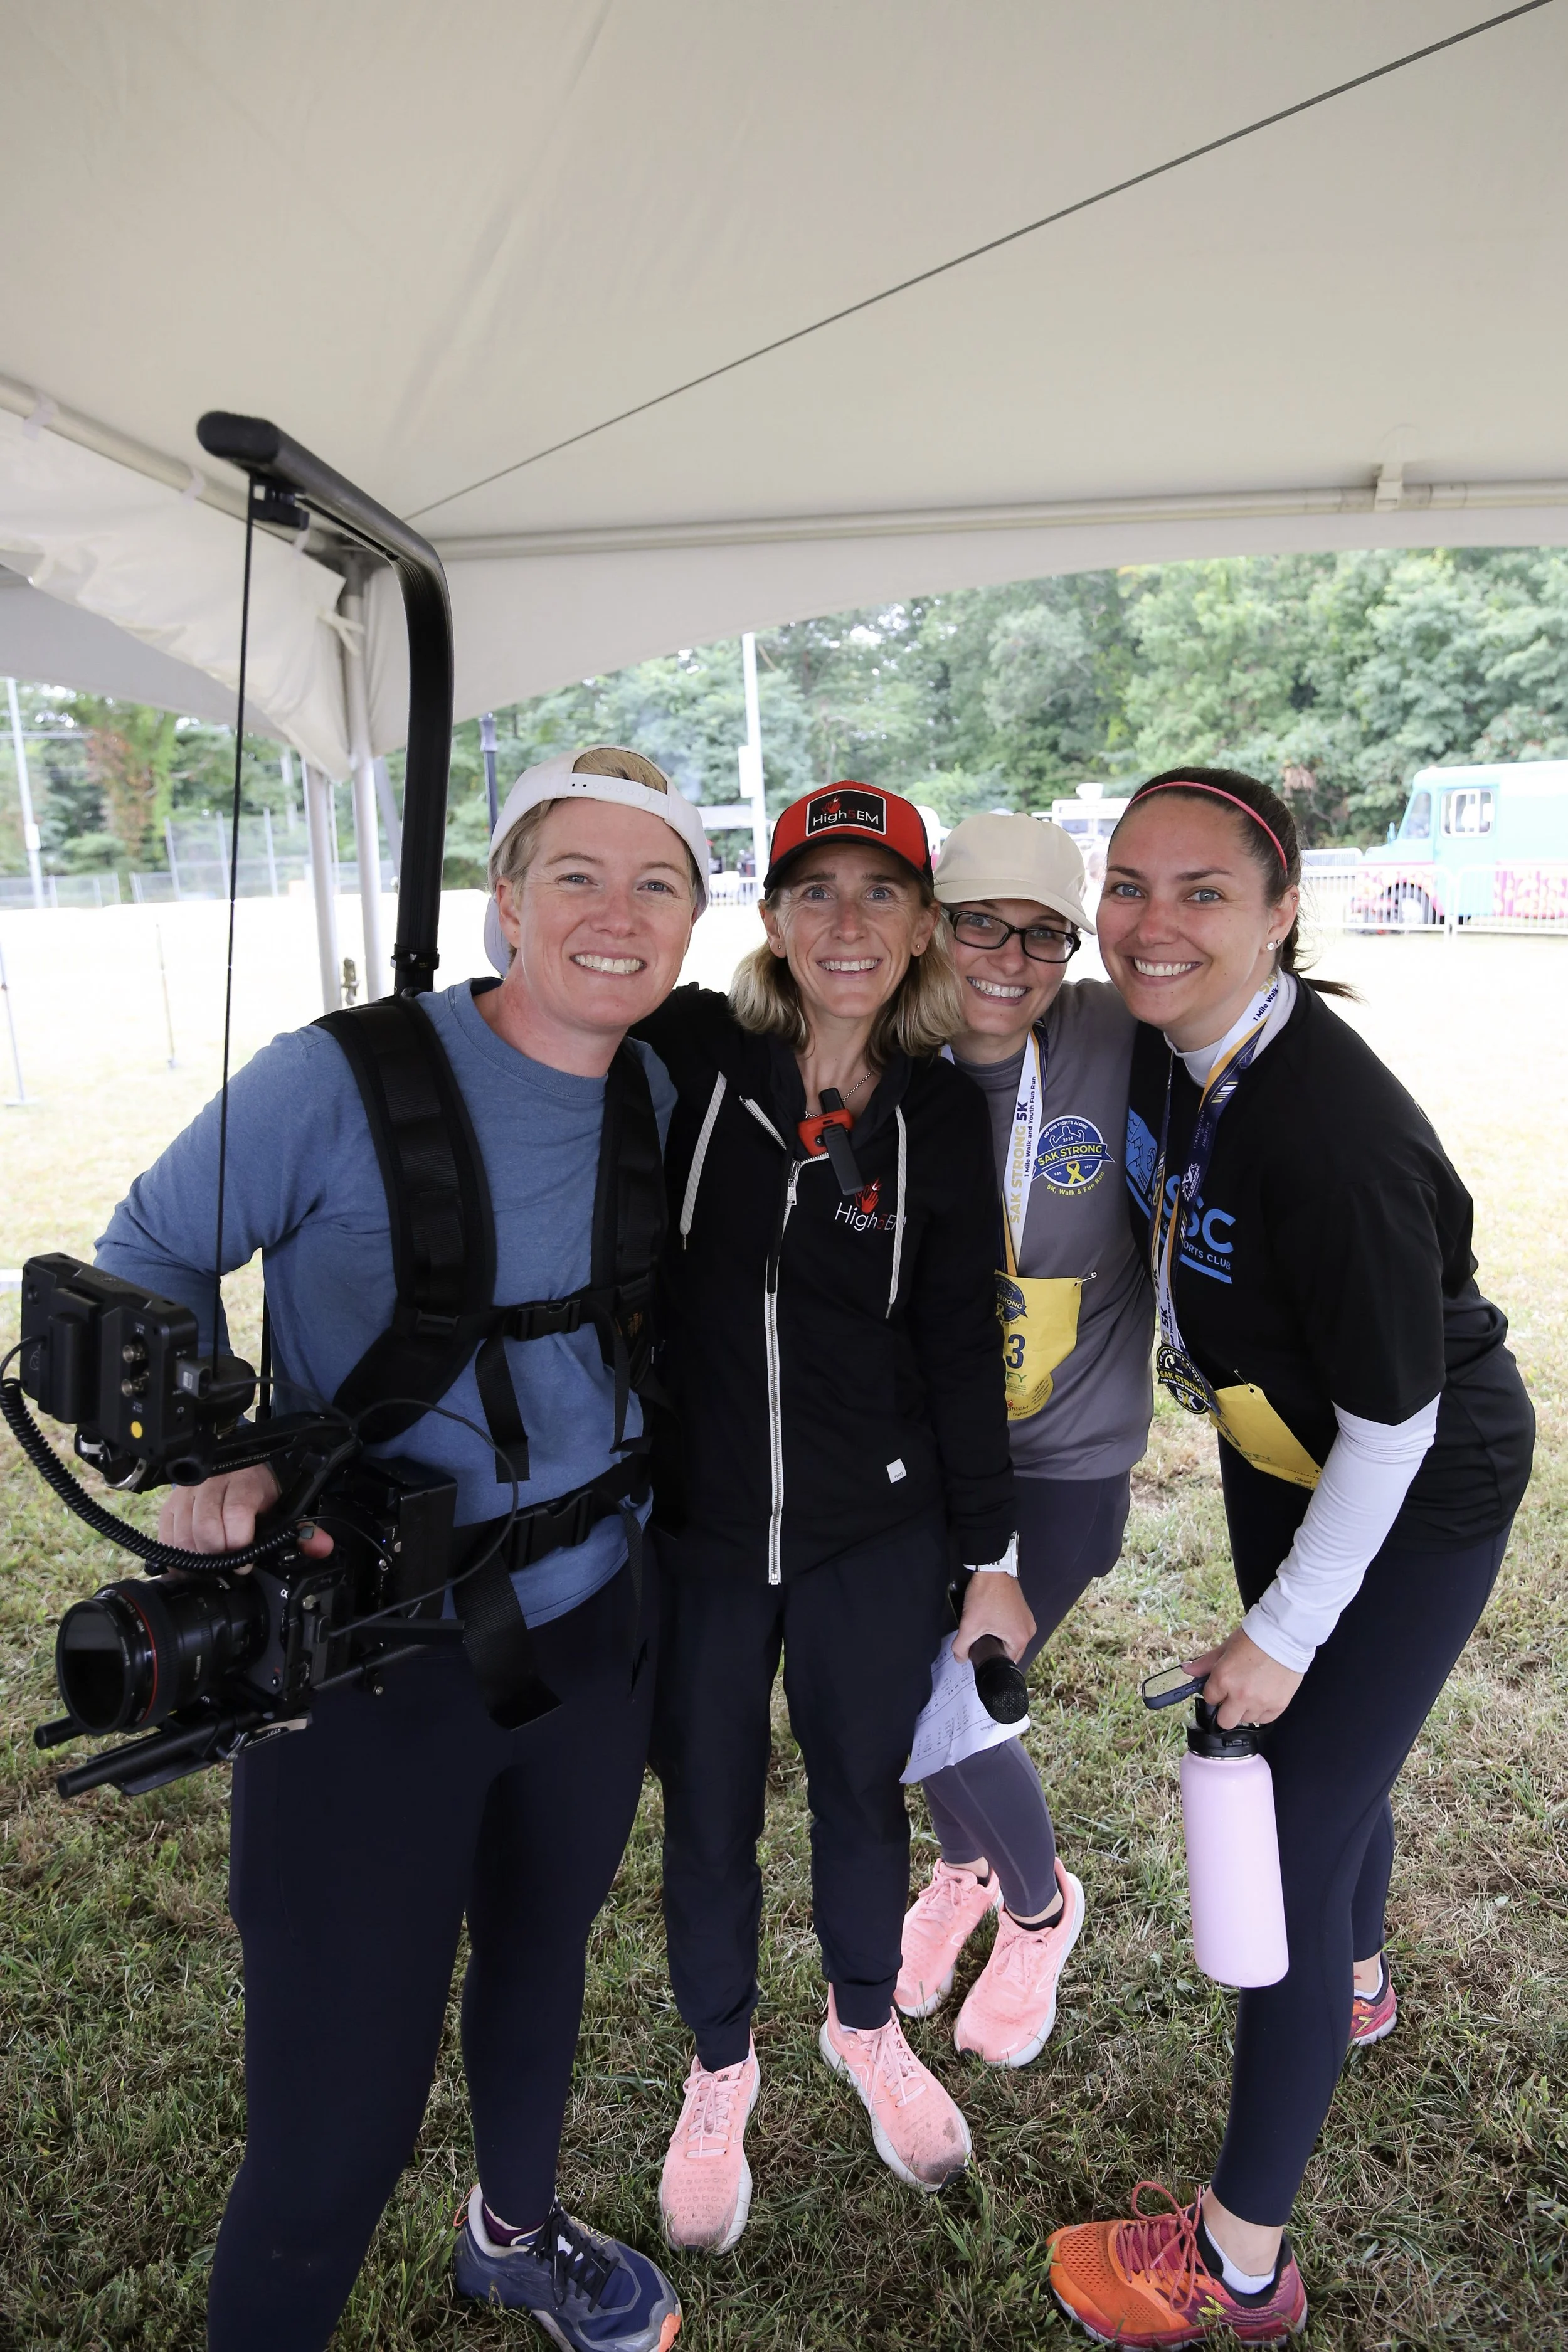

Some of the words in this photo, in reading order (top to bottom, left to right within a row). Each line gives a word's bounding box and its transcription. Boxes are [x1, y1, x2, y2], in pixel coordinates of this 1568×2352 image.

[813, 810, 879, 827] High5EM
[1256, 1003, 1268, 1017] Mile
[1265, 987, 1278, 1003] Walk
[1016, 1101, 1029, 1121] 5K
[1043, 1131, 1050, 1139] NO
[1048, 1123, 1058, 1133] ONE
[1073, 1121, 1088, 1130] ALONE
[1011, 1125, 1027, 1189] STRONG
[1037, 1150, 1060, 1166] SAK
[1060, 1145, 1103, 1157] STRONG
[1059, 1153, 1083, 1162] FOUNDATION
[1046, 1184, 1057, 1194] 5K,
[1083, 1184, 1095, 1193] Fun
[1094, 1171, 1104, 1185] Run
[1010, 1192, 1022, 1224] SAK
[1153, 1168, 1236, 1254] SSC
[1183, 1240, 1204, 1259] ORTS
[1206, 1253, 1231, 1271] CLUB
[996, 1293, 1023, 1310] STRONG
[1160, 1305, 1169, 1328] 5K
[1005, 1333, 1025, 1369] 3
[1160, 1370, 1171, 1379] SAK
[1171, 1374, 1206, 1401] STRONG
